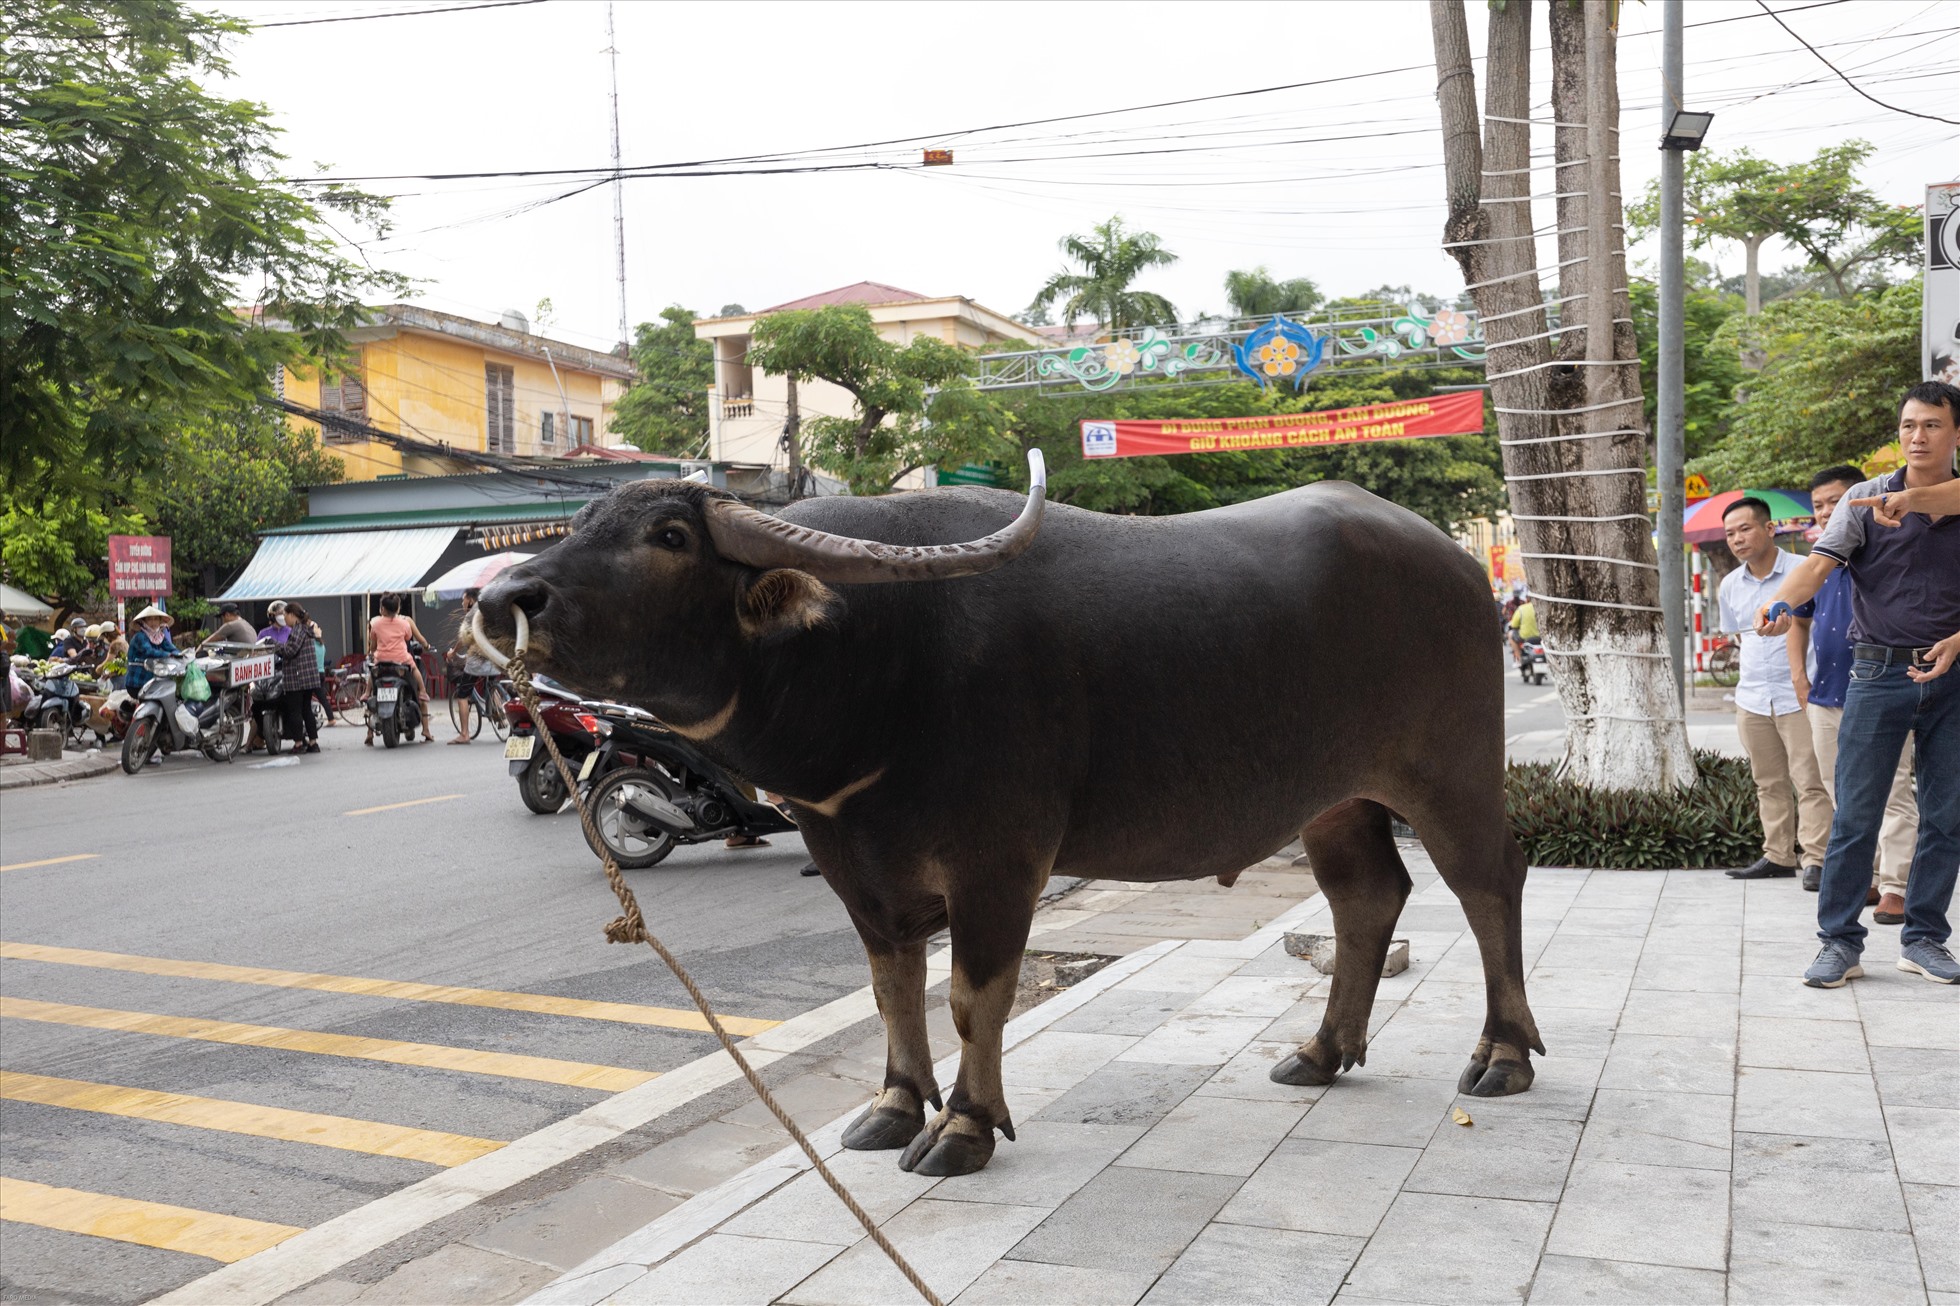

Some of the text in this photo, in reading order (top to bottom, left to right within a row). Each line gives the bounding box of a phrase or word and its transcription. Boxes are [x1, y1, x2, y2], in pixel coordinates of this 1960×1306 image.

[1189, 420, 1405, 450] GIỮ KHOẢNG CÁCH AN TOÀN
[235, 663, 253, 682] BÁNH
[253, 662, 263, 679] ĐA
